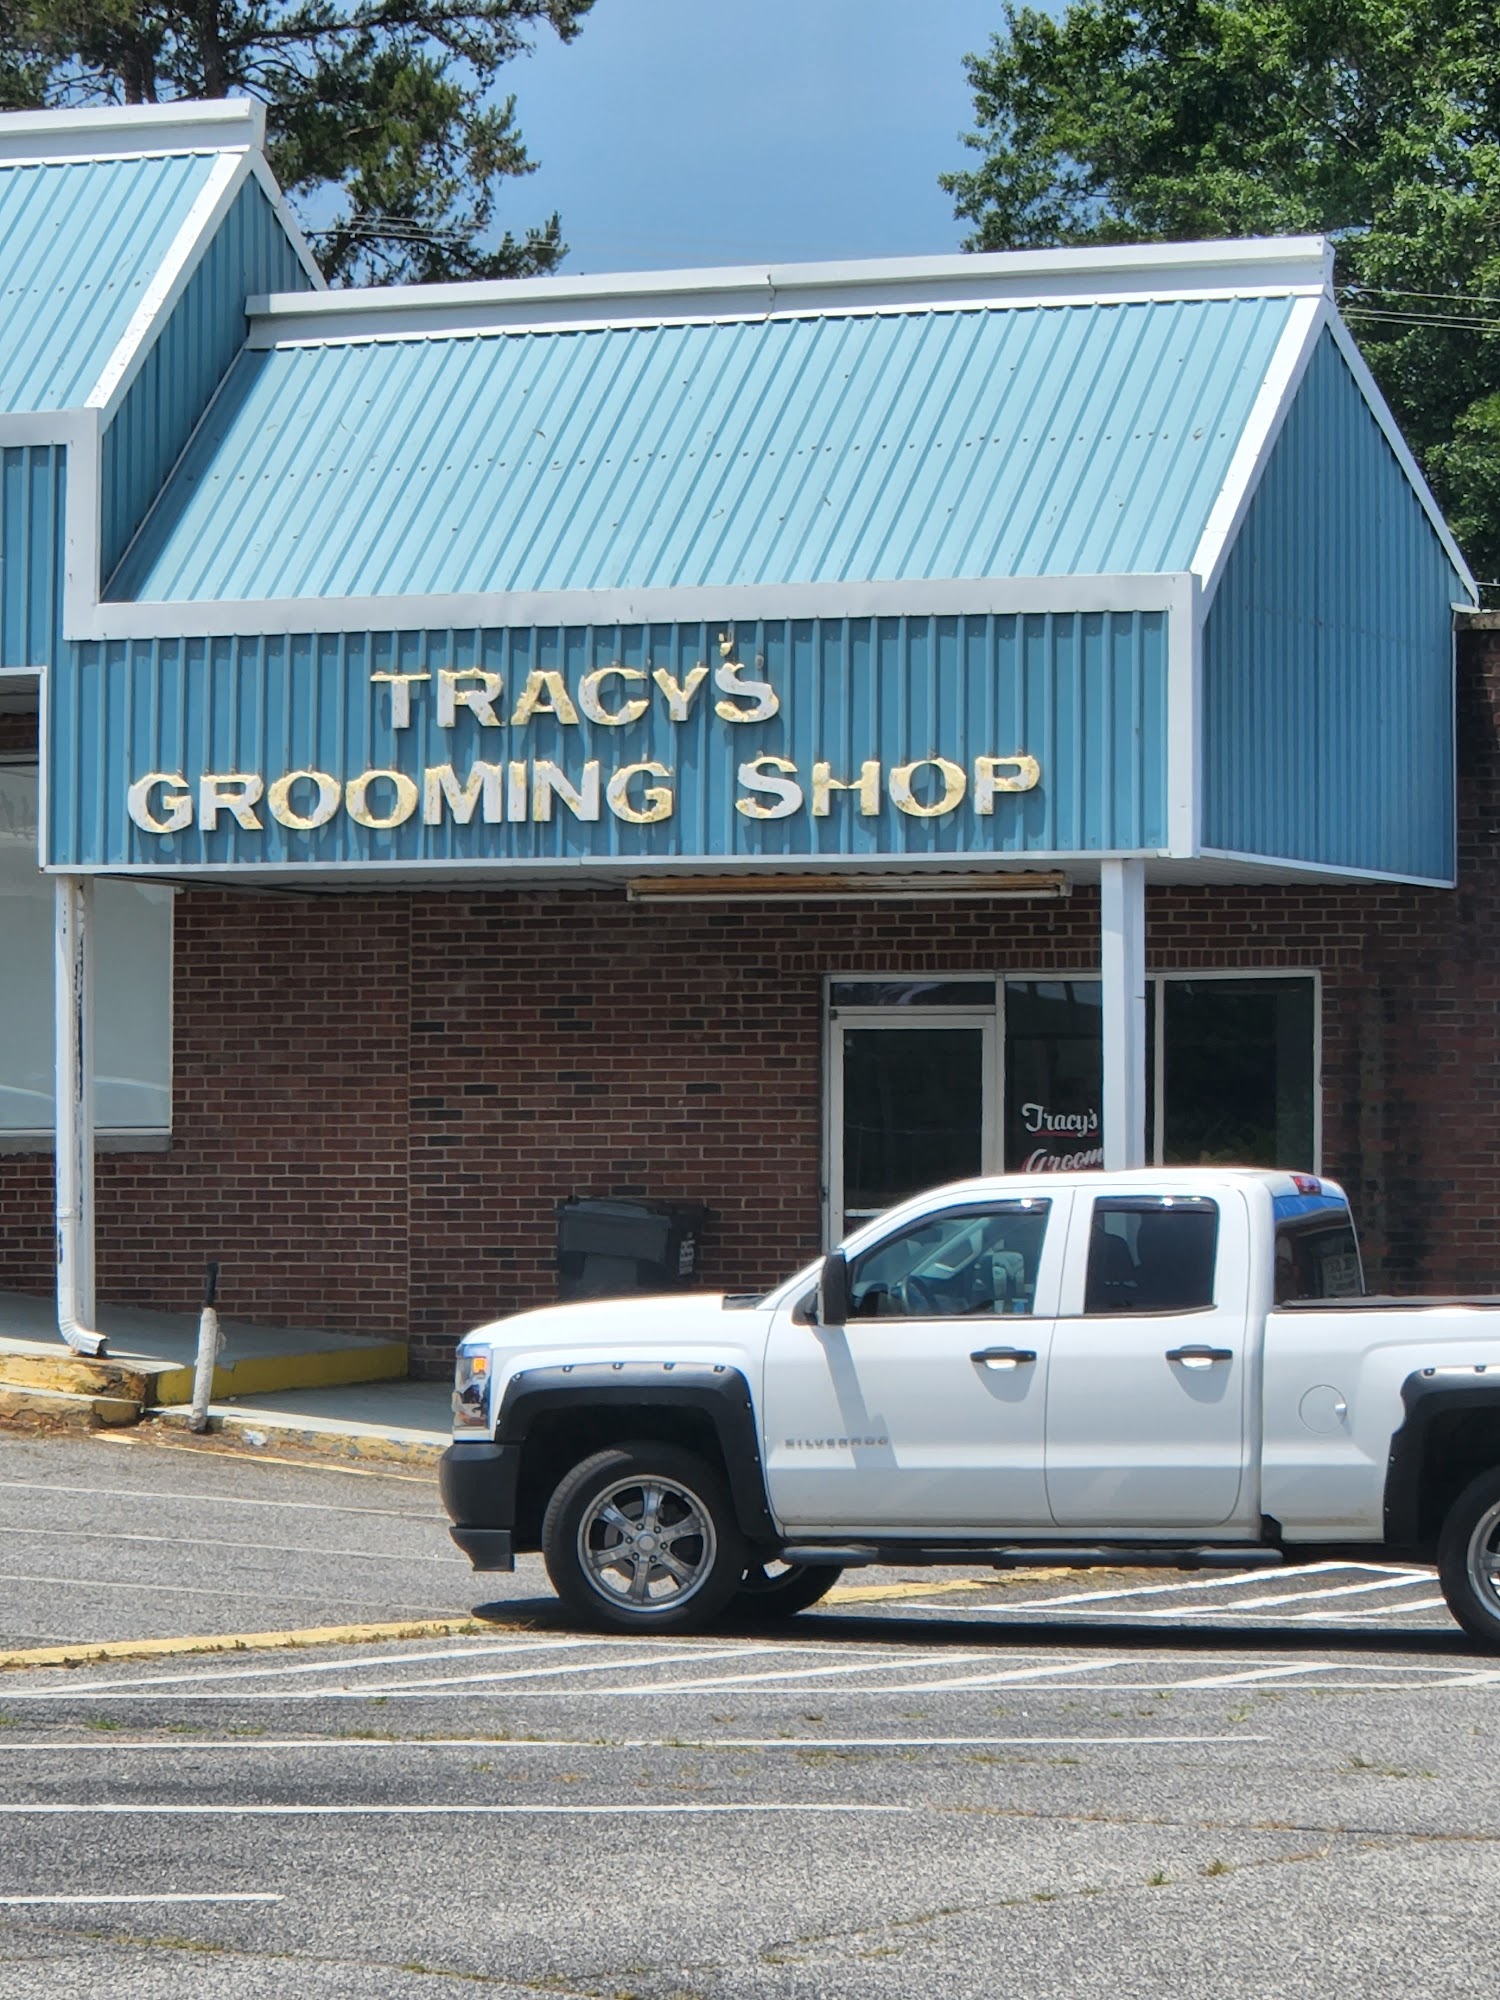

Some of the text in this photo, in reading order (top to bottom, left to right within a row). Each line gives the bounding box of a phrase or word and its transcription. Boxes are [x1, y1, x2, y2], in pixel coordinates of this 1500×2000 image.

[370, 632, 780, 730] TRACY'S
[127, 756, 1041, 834] GROOMING SHOP
[1021, 1103, 1098, 1137] Tracy's
[784, 1436, 888, 1449] SILVERADO
